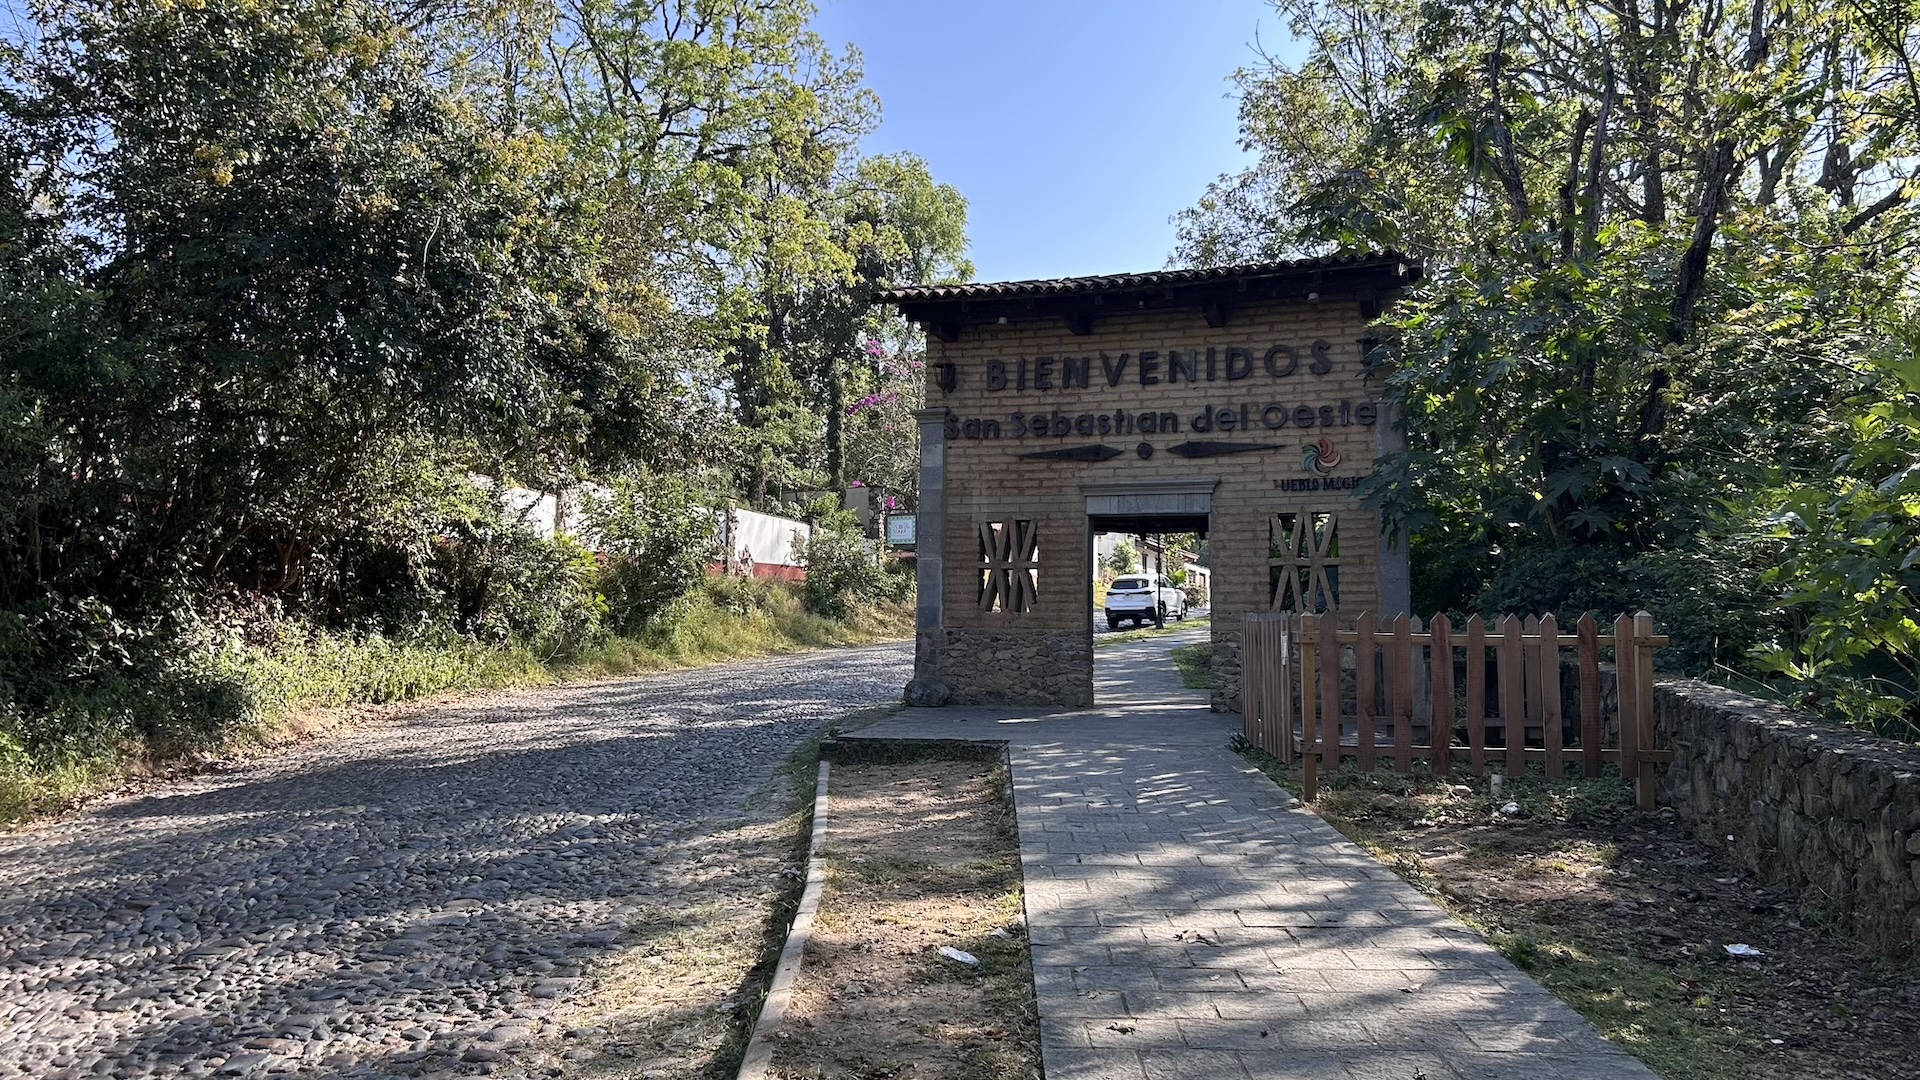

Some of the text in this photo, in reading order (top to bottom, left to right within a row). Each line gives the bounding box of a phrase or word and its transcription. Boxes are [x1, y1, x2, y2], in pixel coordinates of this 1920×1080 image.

[986, 338, 1333, 393] BIENVENIDOS
[944, 400, 1377, 440] San Sebastian del Oeste
